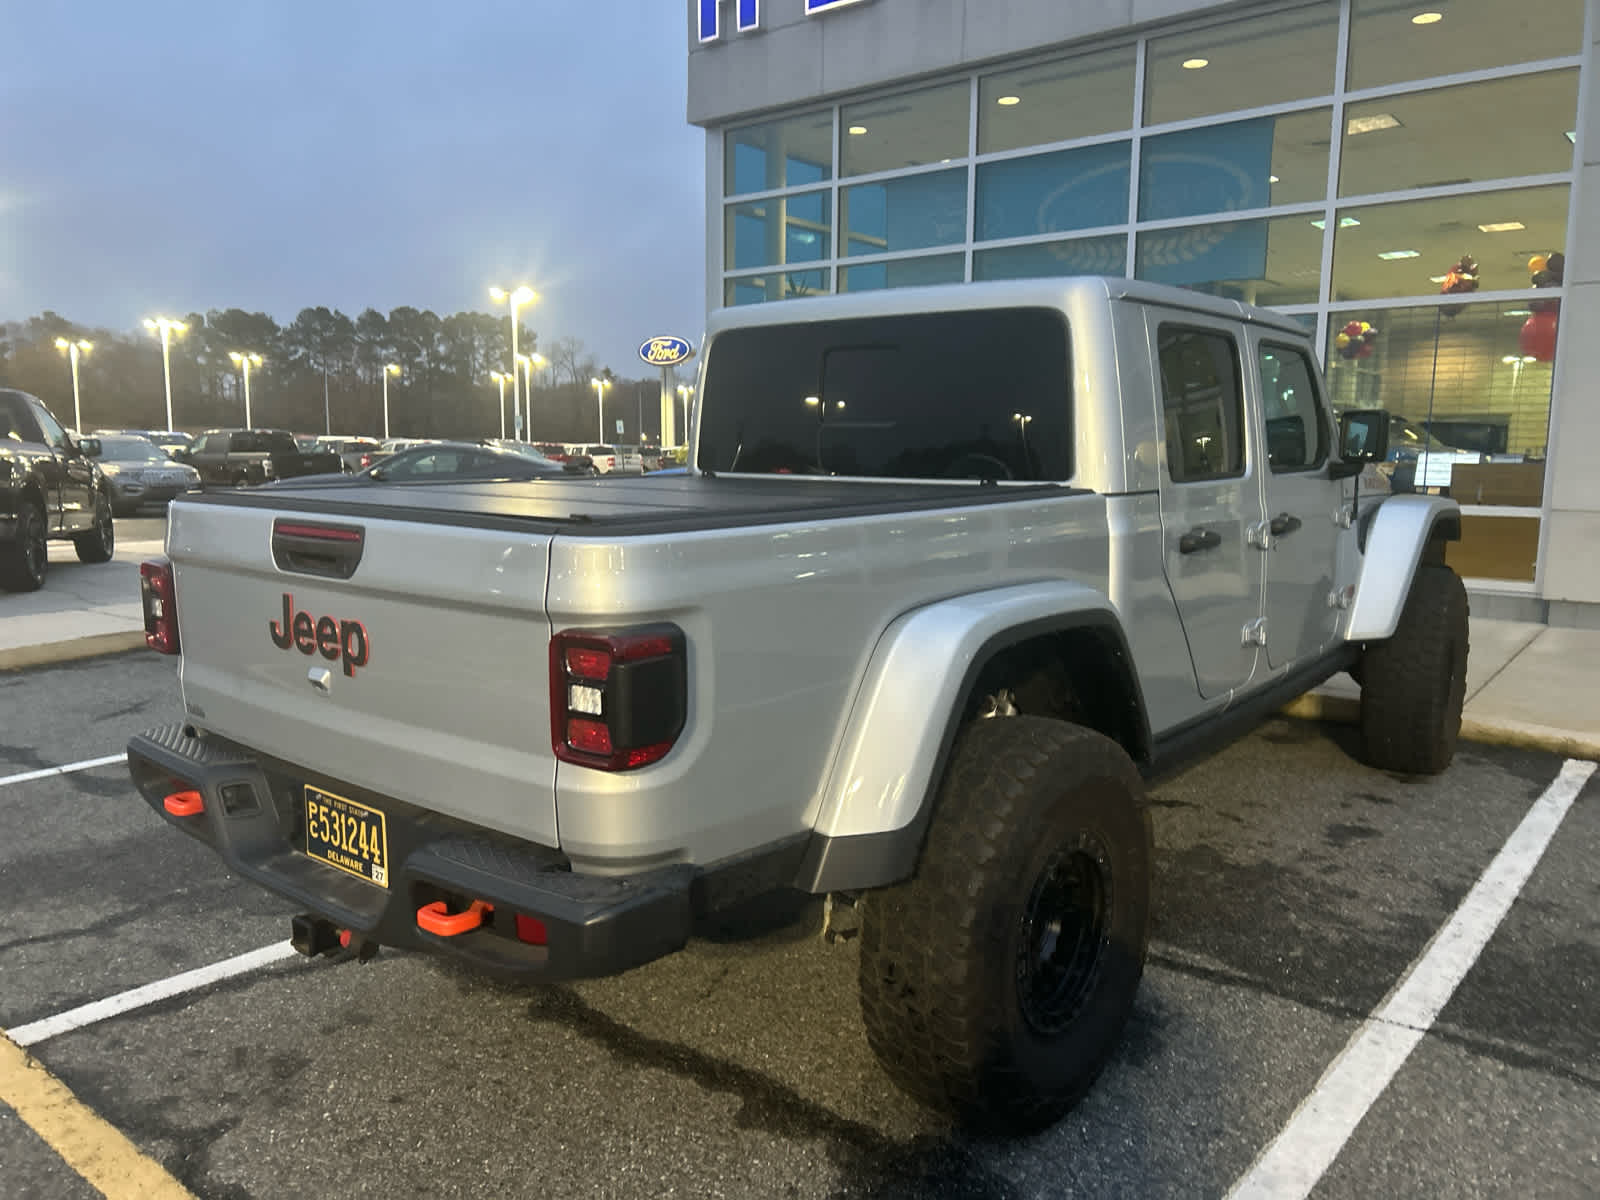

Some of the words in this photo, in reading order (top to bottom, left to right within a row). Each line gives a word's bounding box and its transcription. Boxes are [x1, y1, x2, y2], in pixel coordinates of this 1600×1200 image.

[647, 340, 680, 361] Ford
[269, 592, 369, 678] Jeep
[319, 804, 381, 864] 531244
[327, 849, 364, 873] DELAWARE
[375, 870, 384, 881] 27
